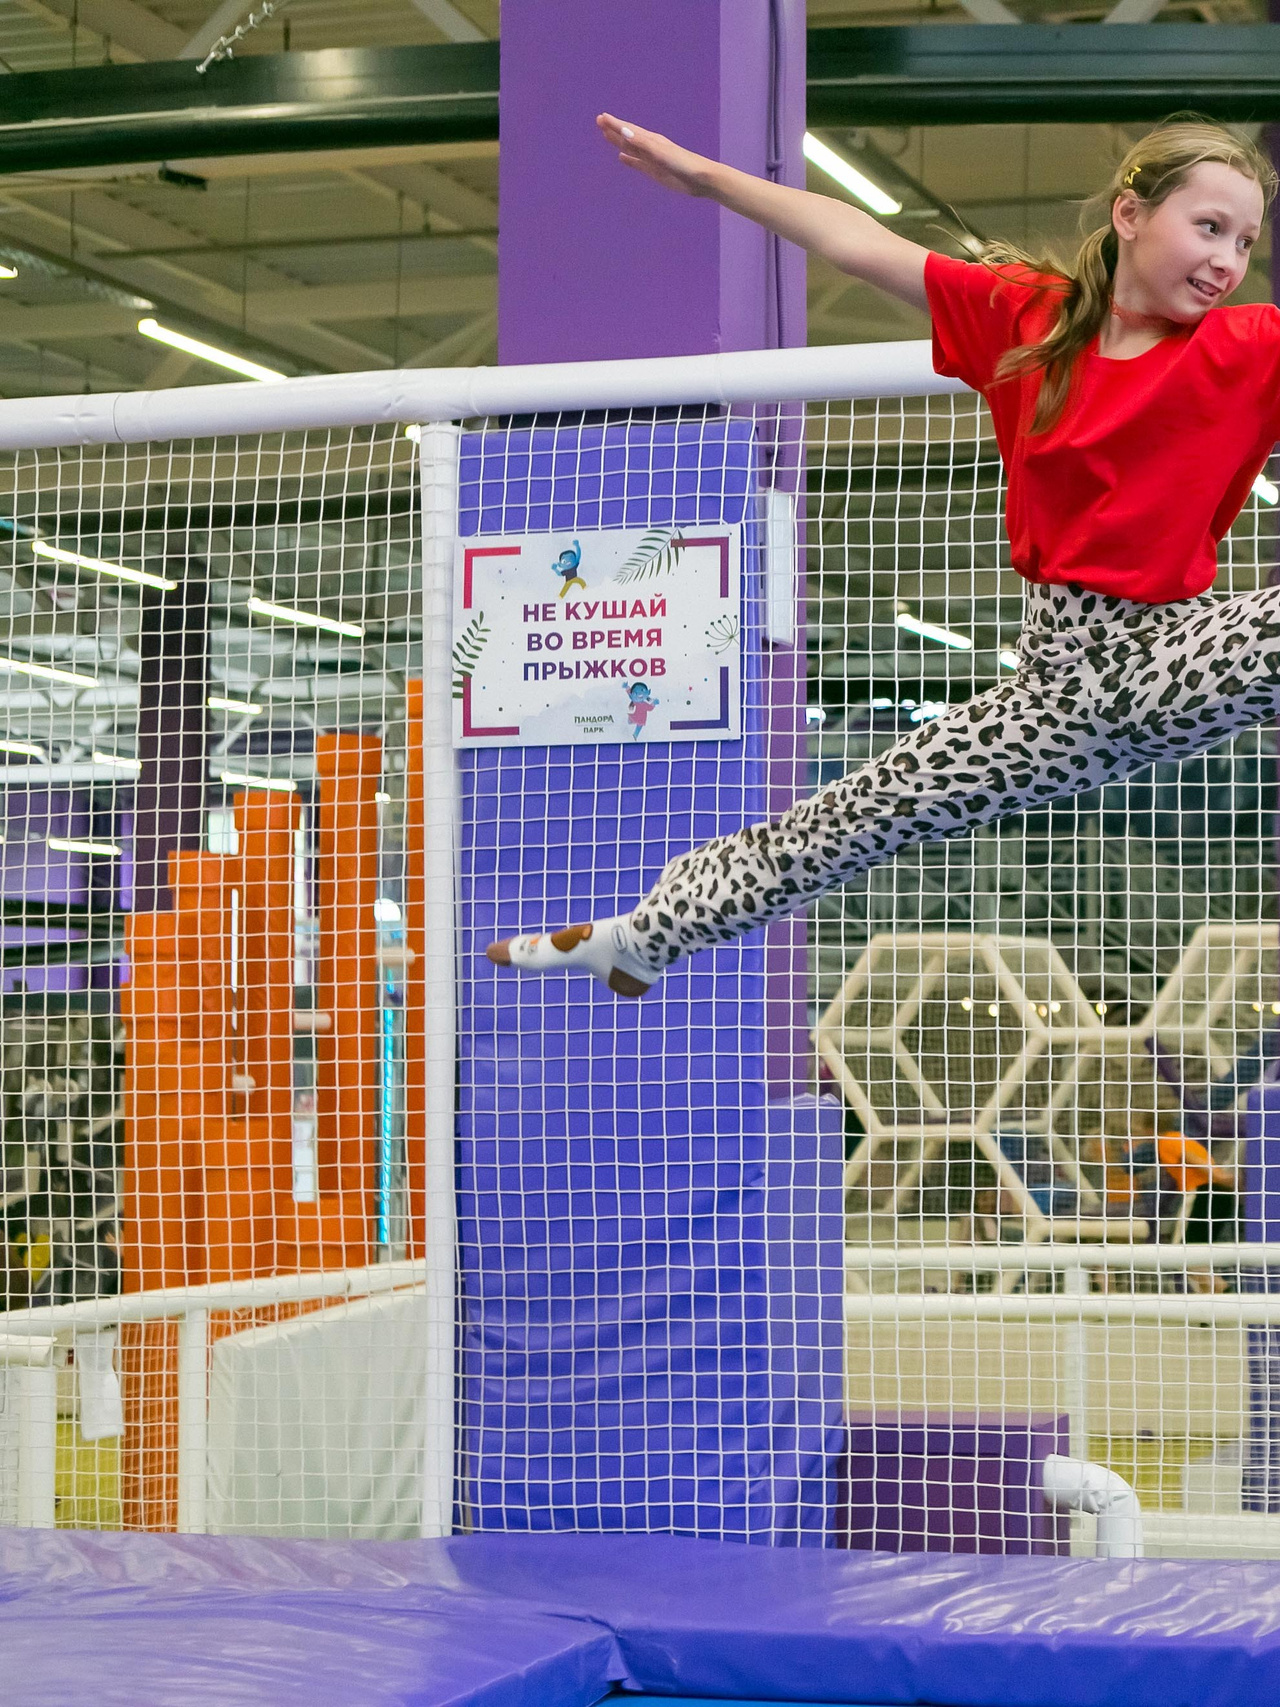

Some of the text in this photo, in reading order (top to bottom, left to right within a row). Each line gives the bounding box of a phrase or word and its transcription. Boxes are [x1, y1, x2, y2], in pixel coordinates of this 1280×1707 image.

[523, 593, 667, 622] НЕ КУШАЙ
[527, 628, 662, 651] ВО ВРЕМЯ
[523, 658, 666, 681] ПРЫЖКОВ
[574, 714, 614, 724] ПАНДОРА
